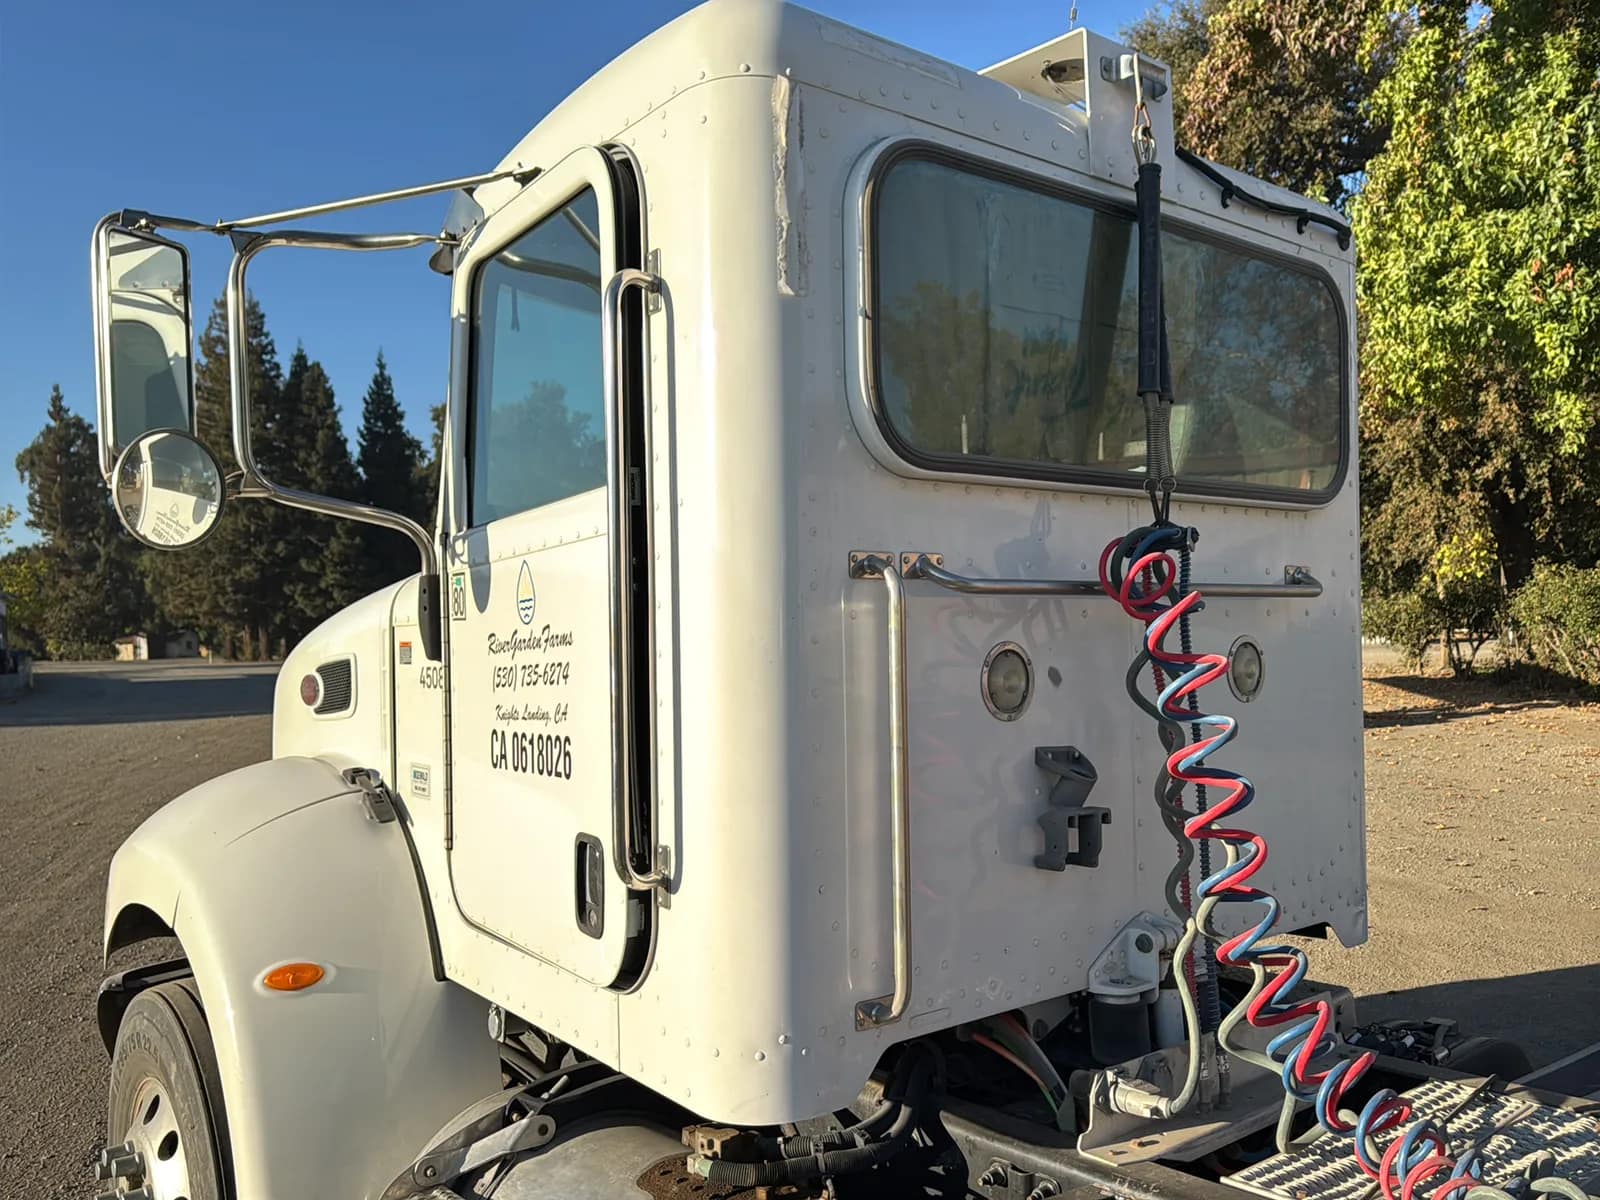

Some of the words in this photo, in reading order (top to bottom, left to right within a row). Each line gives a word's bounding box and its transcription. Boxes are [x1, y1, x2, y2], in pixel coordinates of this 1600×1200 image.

[492, 664, 517, 693] (530)
[521, 661, 570, 687] 735-6274
[496, 704, 519, 726] Knights
[554, 702, 568, 724] CA
[491, 728, 508, 770] CA
[512, 731, 572, 780] 0618026
